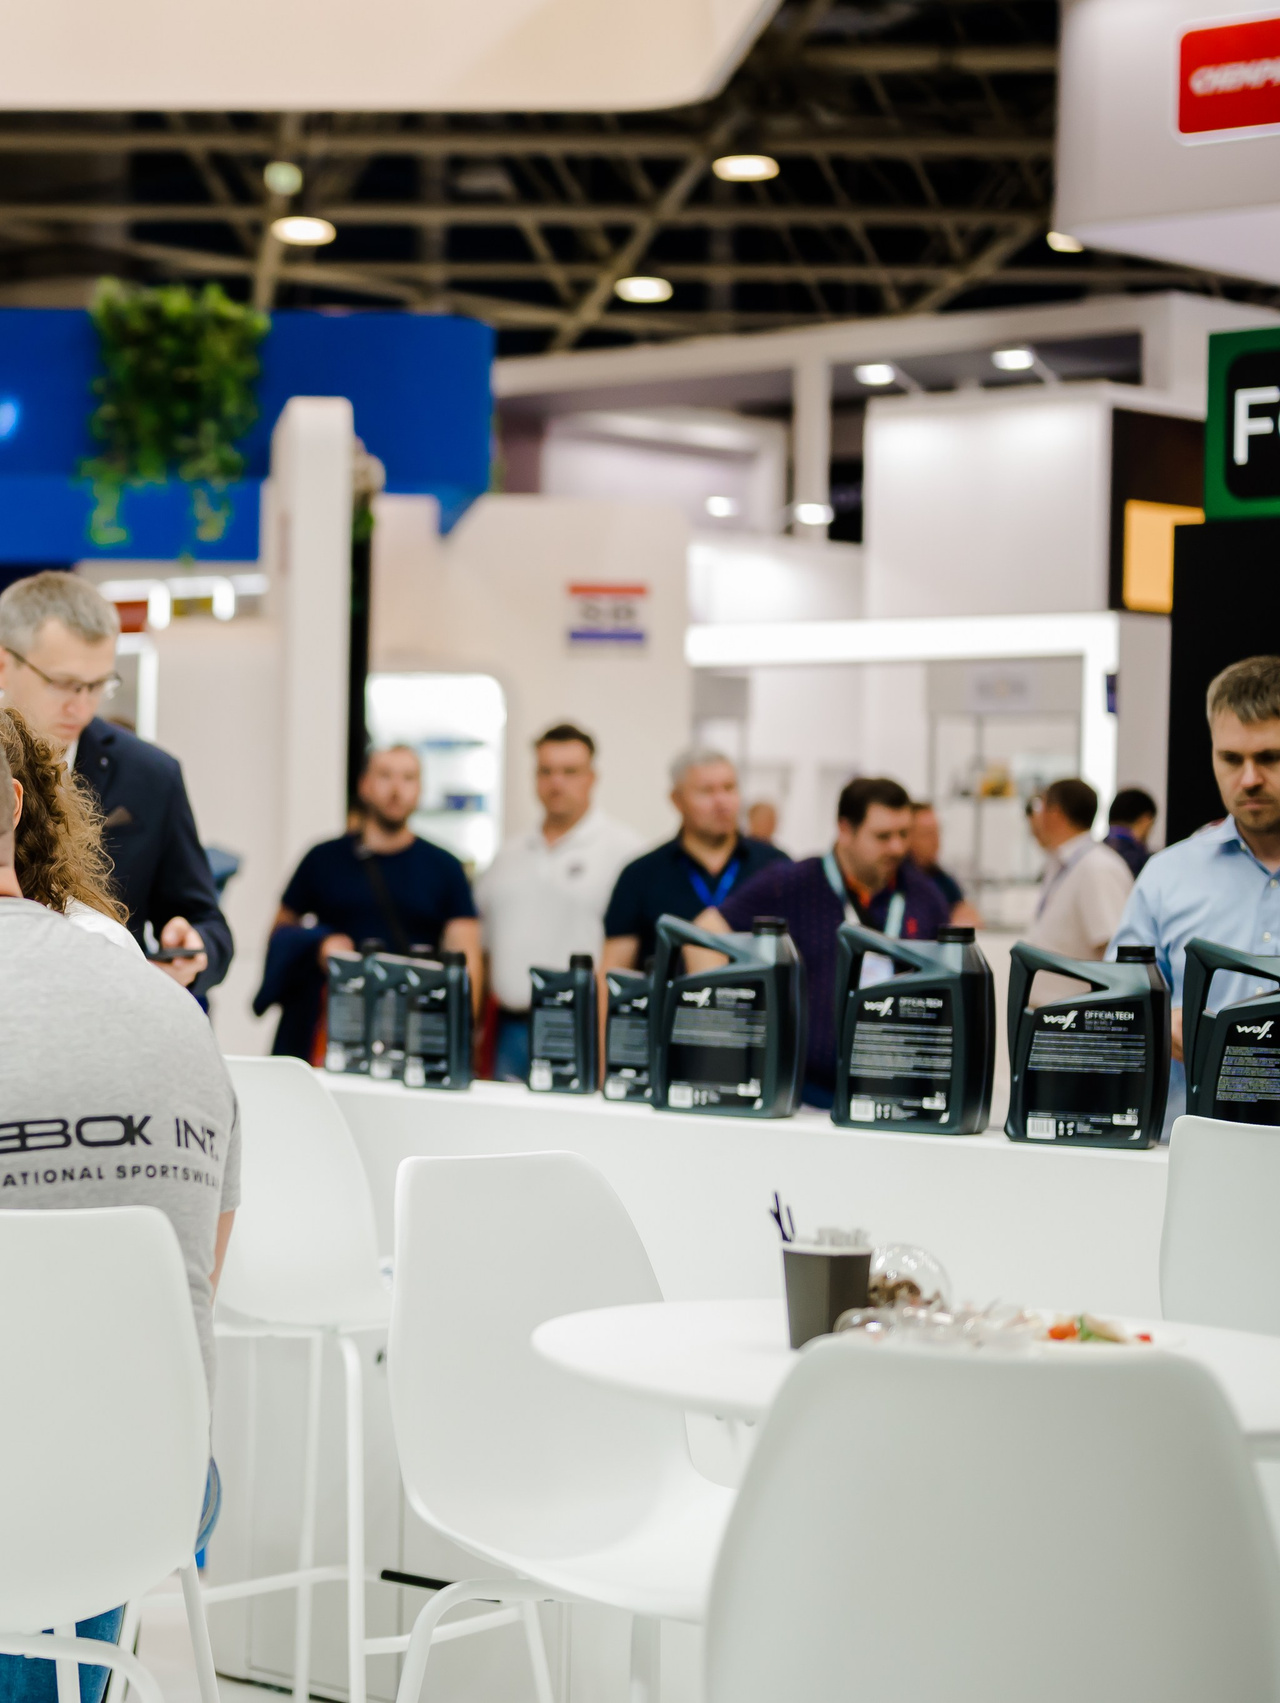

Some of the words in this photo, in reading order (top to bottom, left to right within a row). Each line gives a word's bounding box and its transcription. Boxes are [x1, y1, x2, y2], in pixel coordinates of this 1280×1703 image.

[1232, 385, 1280, 466] F
[1236, 1020, 1275, 1040] wolf
[175, 1117, 219, 1162] INT.
